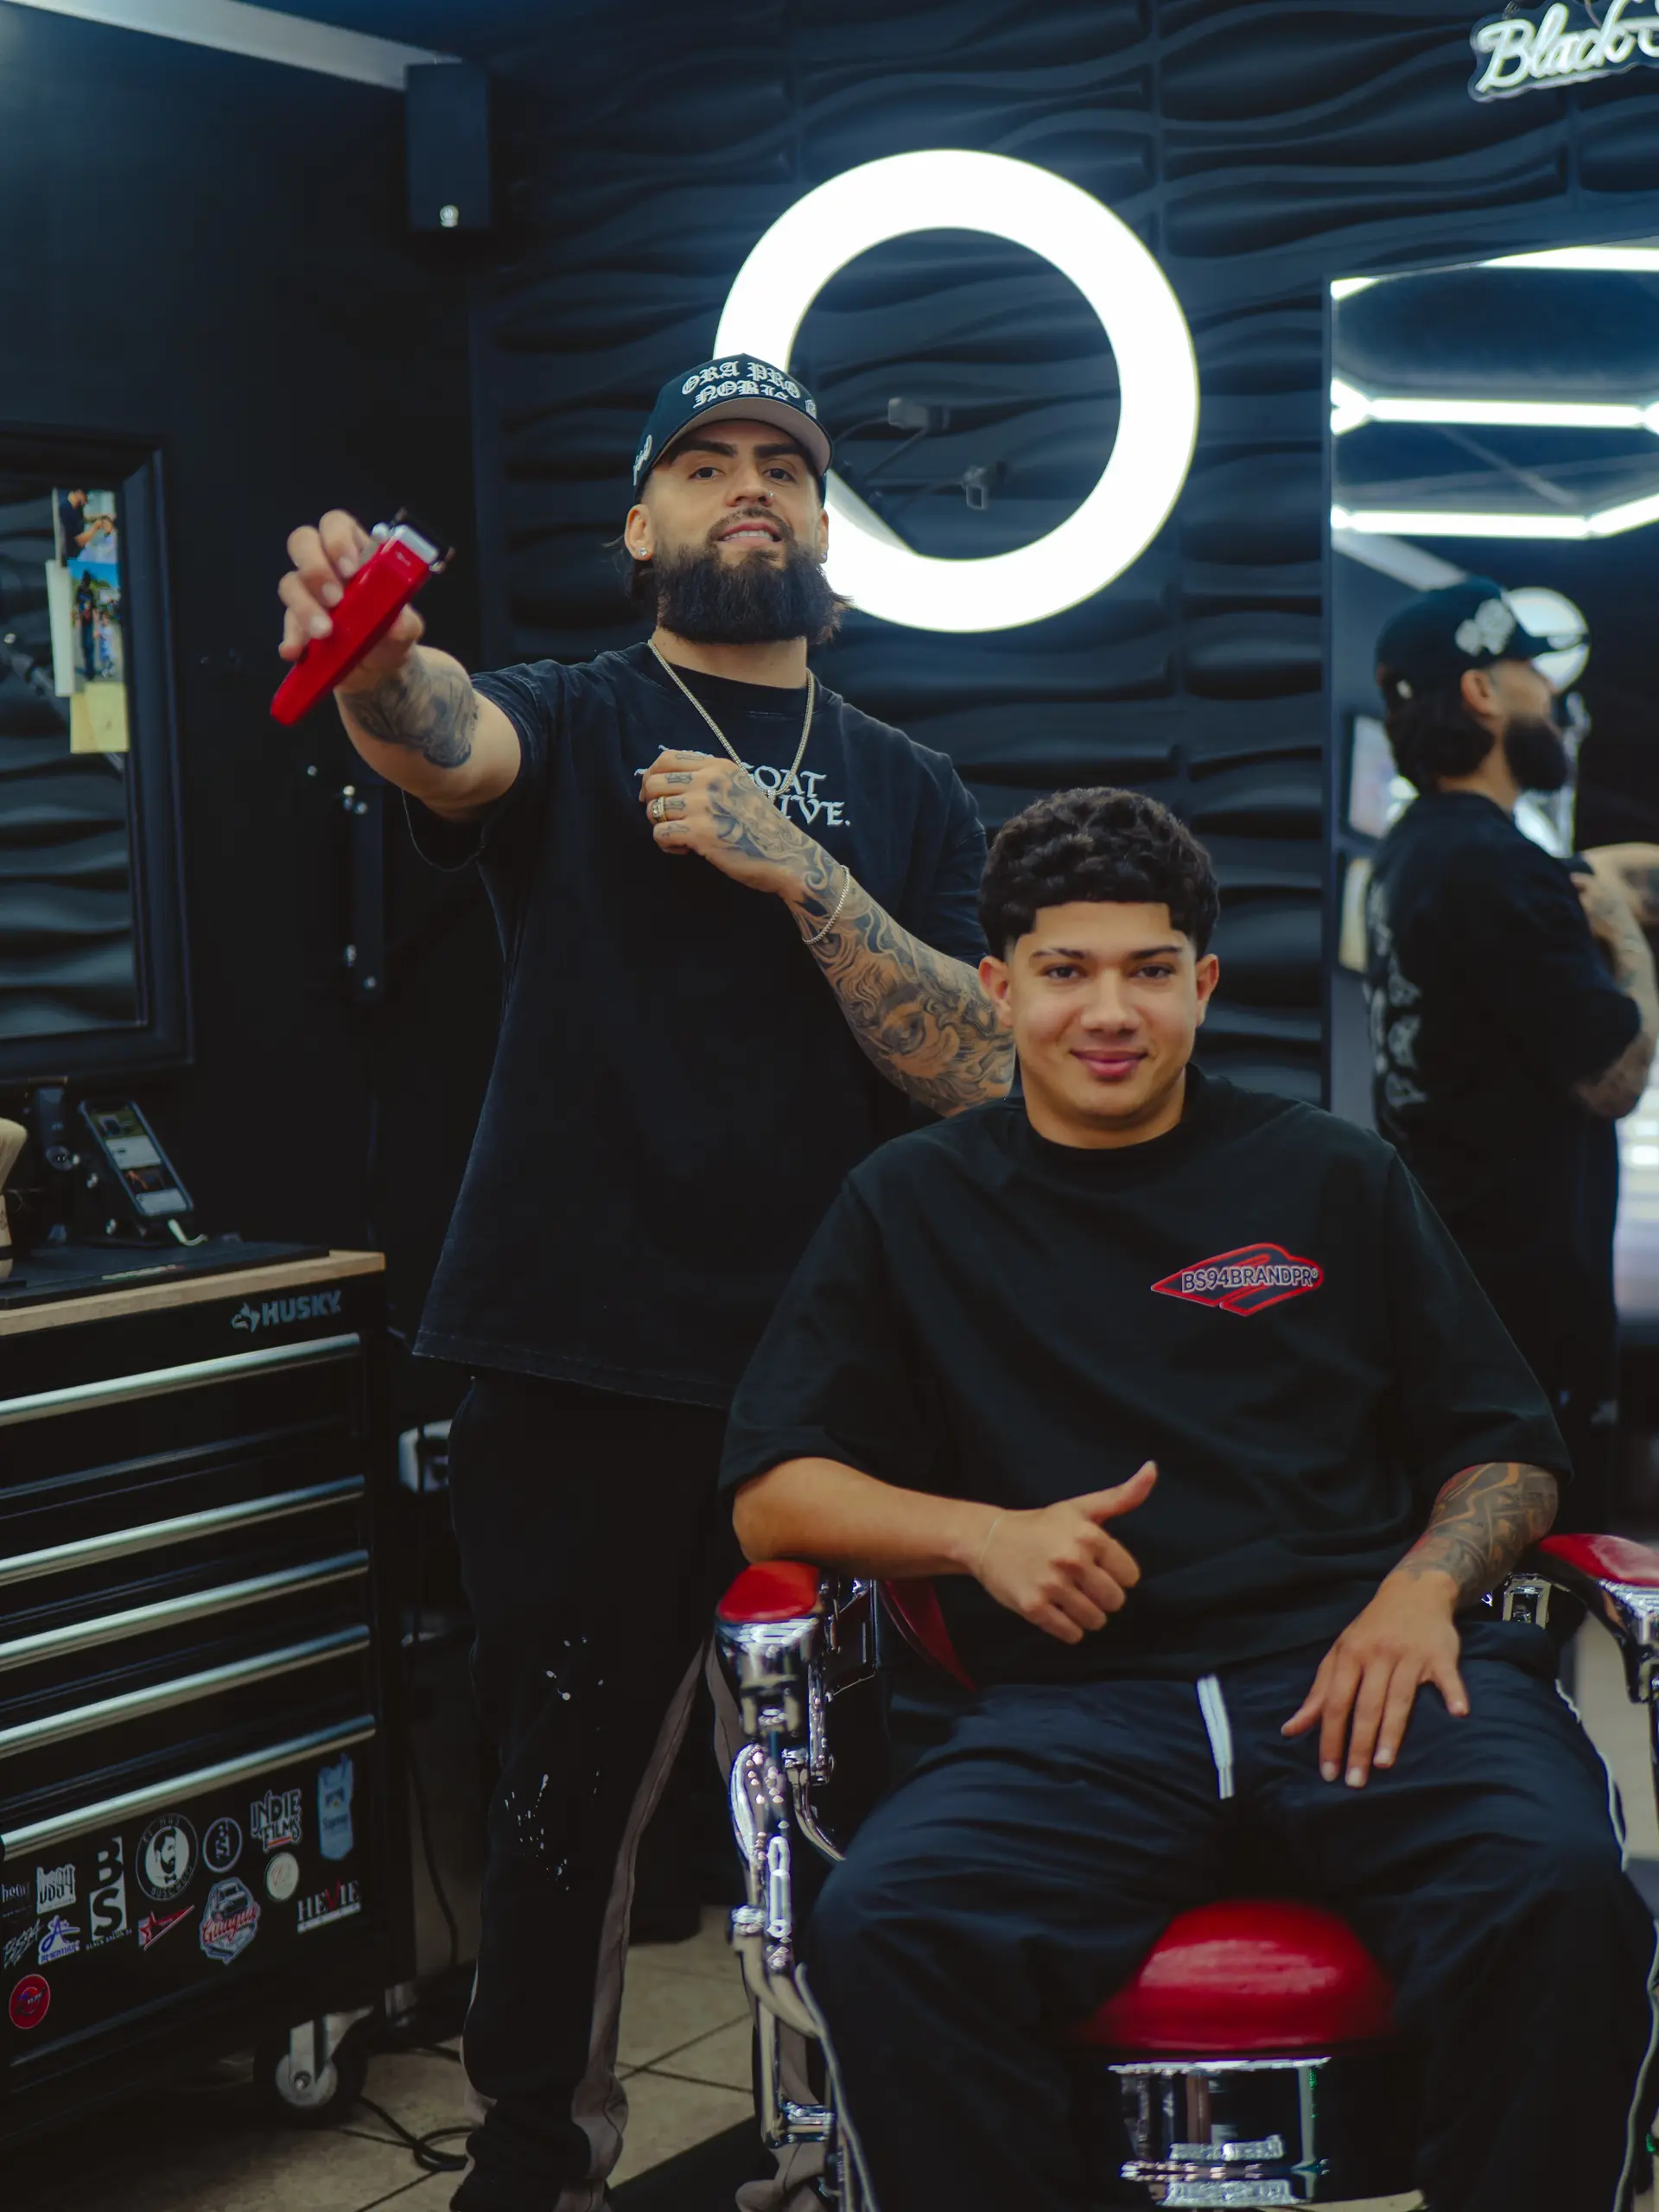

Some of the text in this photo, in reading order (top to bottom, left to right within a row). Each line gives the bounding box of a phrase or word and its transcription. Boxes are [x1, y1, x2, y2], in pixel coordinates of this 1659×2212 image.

[682, 361, 801, 399] ORA PRO
[777, 794, 851, 826] IVE.
[261, 1289, 342, 1327] HUSKY
[251, 1788, 302, 1831] INDIE
